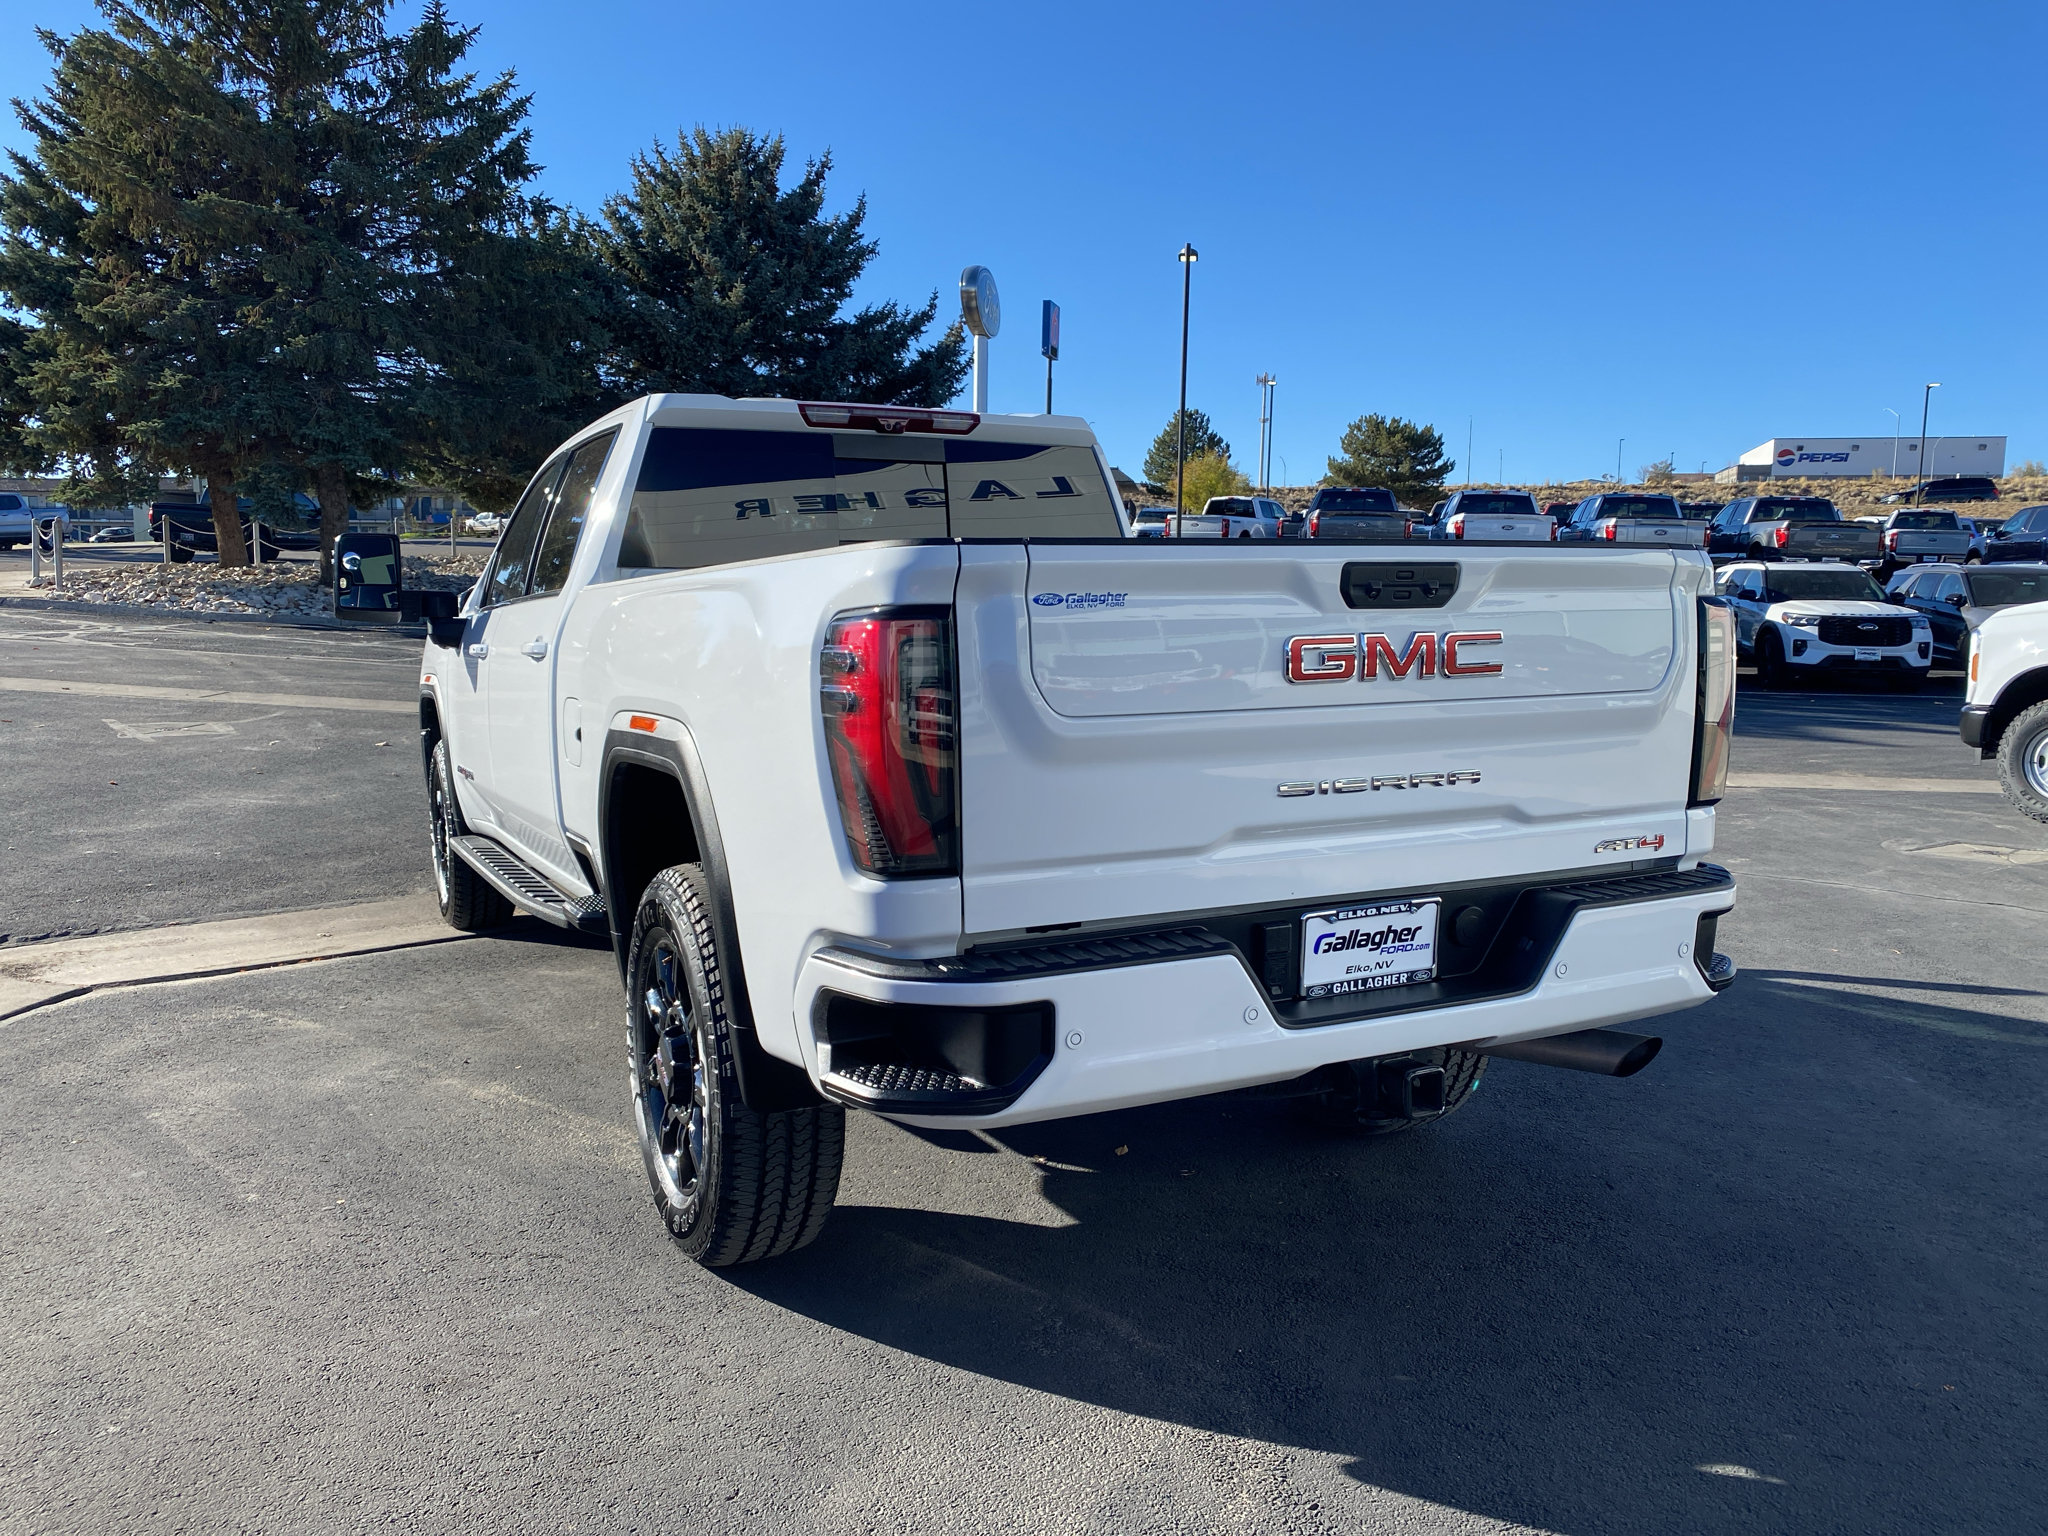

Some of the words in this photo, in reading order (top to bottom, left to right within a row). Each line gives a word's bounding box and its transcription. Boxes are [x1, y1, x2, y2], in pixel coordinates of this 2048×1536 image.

[1797, 452, 1850, 463] PEPSI
[1036, 594, 1061, 605] Ford
[1065, 592, 1128, 604] Gallagher
[1283, 631, 1503, 685] GMC
[1277, 769, 1481, 797] SIERRA
[1594, 834, 1665, 853] AT4
[1380, 904, 1410, 914] NEV.
[1313, 925, 1423, 954] Gallagher
[1380, 943, 1430, 955] FORD.com
[1345, 964, 1373, 974] Elko,
[1374, 960, 1394, 970] NV
[1310, 986, 1327, 996] Ford
[1333, 973, 1408, 994] GALLAGHER
[1414, 970, 1430, 980] Ford
